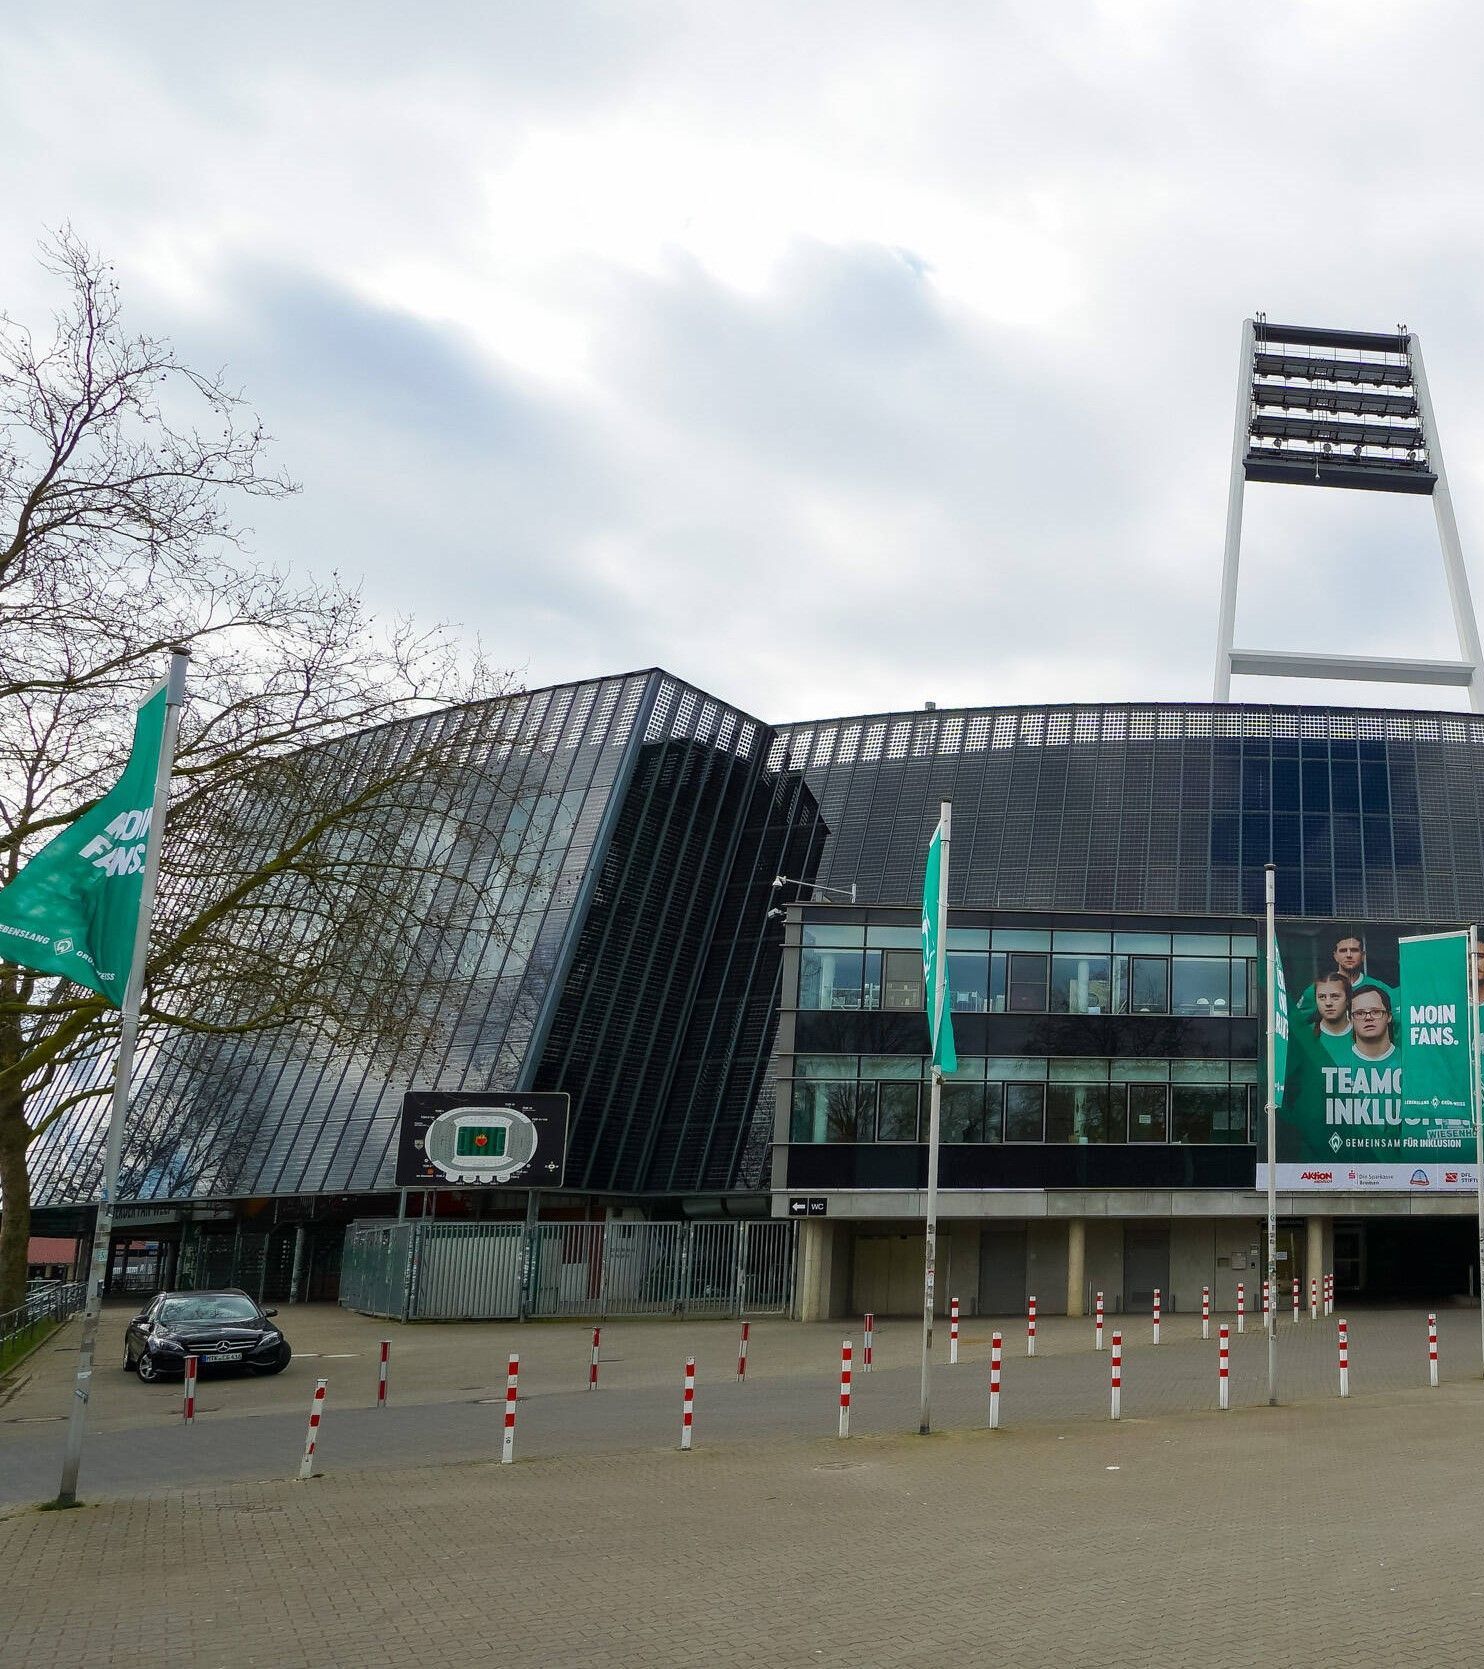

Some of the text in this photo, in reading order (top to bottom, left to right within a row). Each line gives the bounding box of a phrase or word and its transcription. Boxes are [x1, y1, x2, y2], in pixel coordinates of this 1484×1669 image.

[1410, 1004, 1456, 1025] MOIN
[1410, 1027, 1459, 1046] FANS.
[1346, 1136, 1462, 1148] GEMEINSAM FÜR INKLUSION
